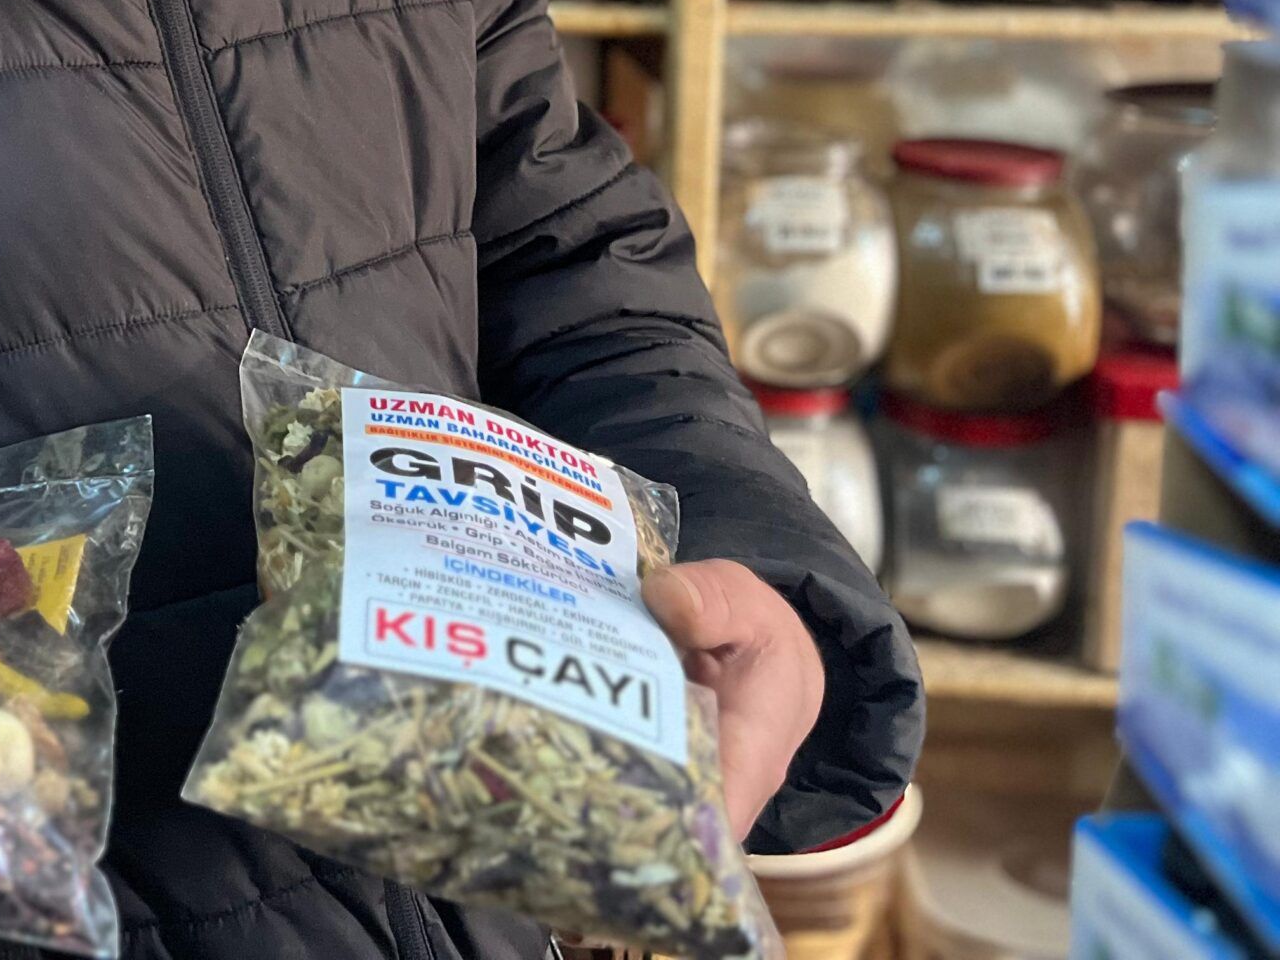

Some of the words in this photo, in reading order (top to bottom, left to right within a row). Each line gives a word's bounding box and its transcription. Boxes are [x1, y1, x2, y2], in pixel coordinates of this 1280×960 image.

[369, 397, 475, 425] UZMAN
[486, 419, 598, 479] DOKTOR
[371, 413, 439, 429] UZMAN
[447, 422, 602, 492] BAHARATÇILARIN
[370, 499, 424, 515] Soğuk
[430, 508, 497, 528] Algınlığı
[371, 513, 447, 530] Öksürük
[465, 527, 503, 546] Grip
[377, 572, 421, 589] TARÇIN
[426, 534, 493, 560] Balgam
[497, 552, 589, 593] Söktürücü
[444, 554, 576, 607] İÇİNDEKİLER
[410, 592, 463, 610] PAPATYA
[375, 607, 488, 668] KIŞ
[505, 636, 651, 720] ÇAYI
